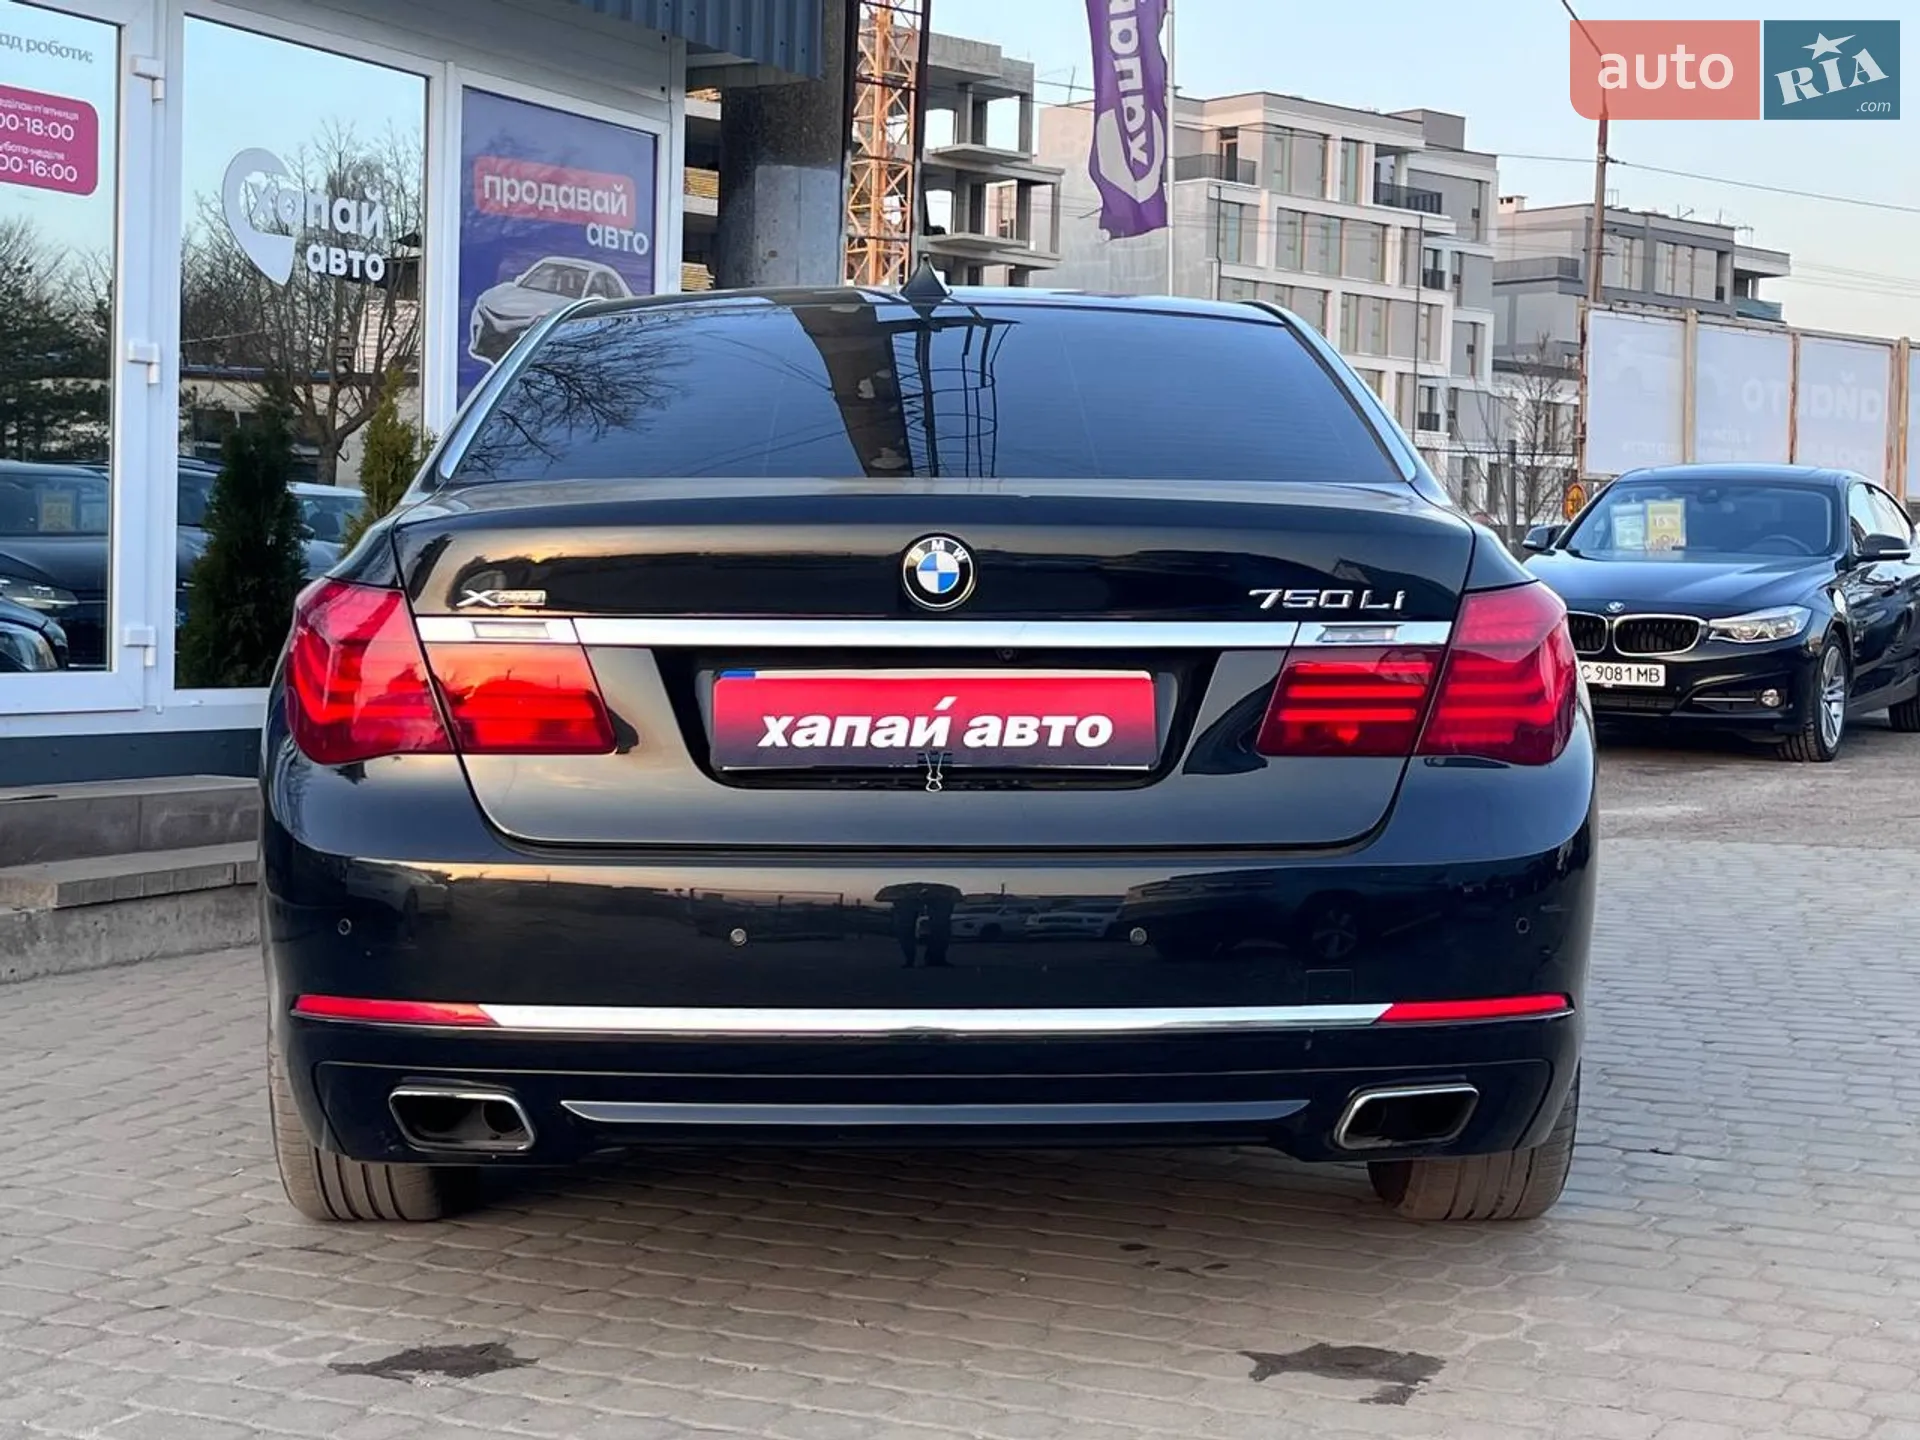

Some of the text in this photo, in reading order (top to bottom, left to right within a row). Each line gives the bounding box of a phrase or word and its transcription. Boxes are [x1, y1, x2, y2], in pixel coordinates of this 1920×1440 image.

[26, 39, 93, 64] роботи:
[249, 182, 385, 240] хапай
[483, 174, 628, 217] продавай
[586, 222, 650, 255] авто
[306, 244, 385, 282] авто
[1595, 664, 1633, 683] 9081
[757, 695, 1114, 748] хапай авто
